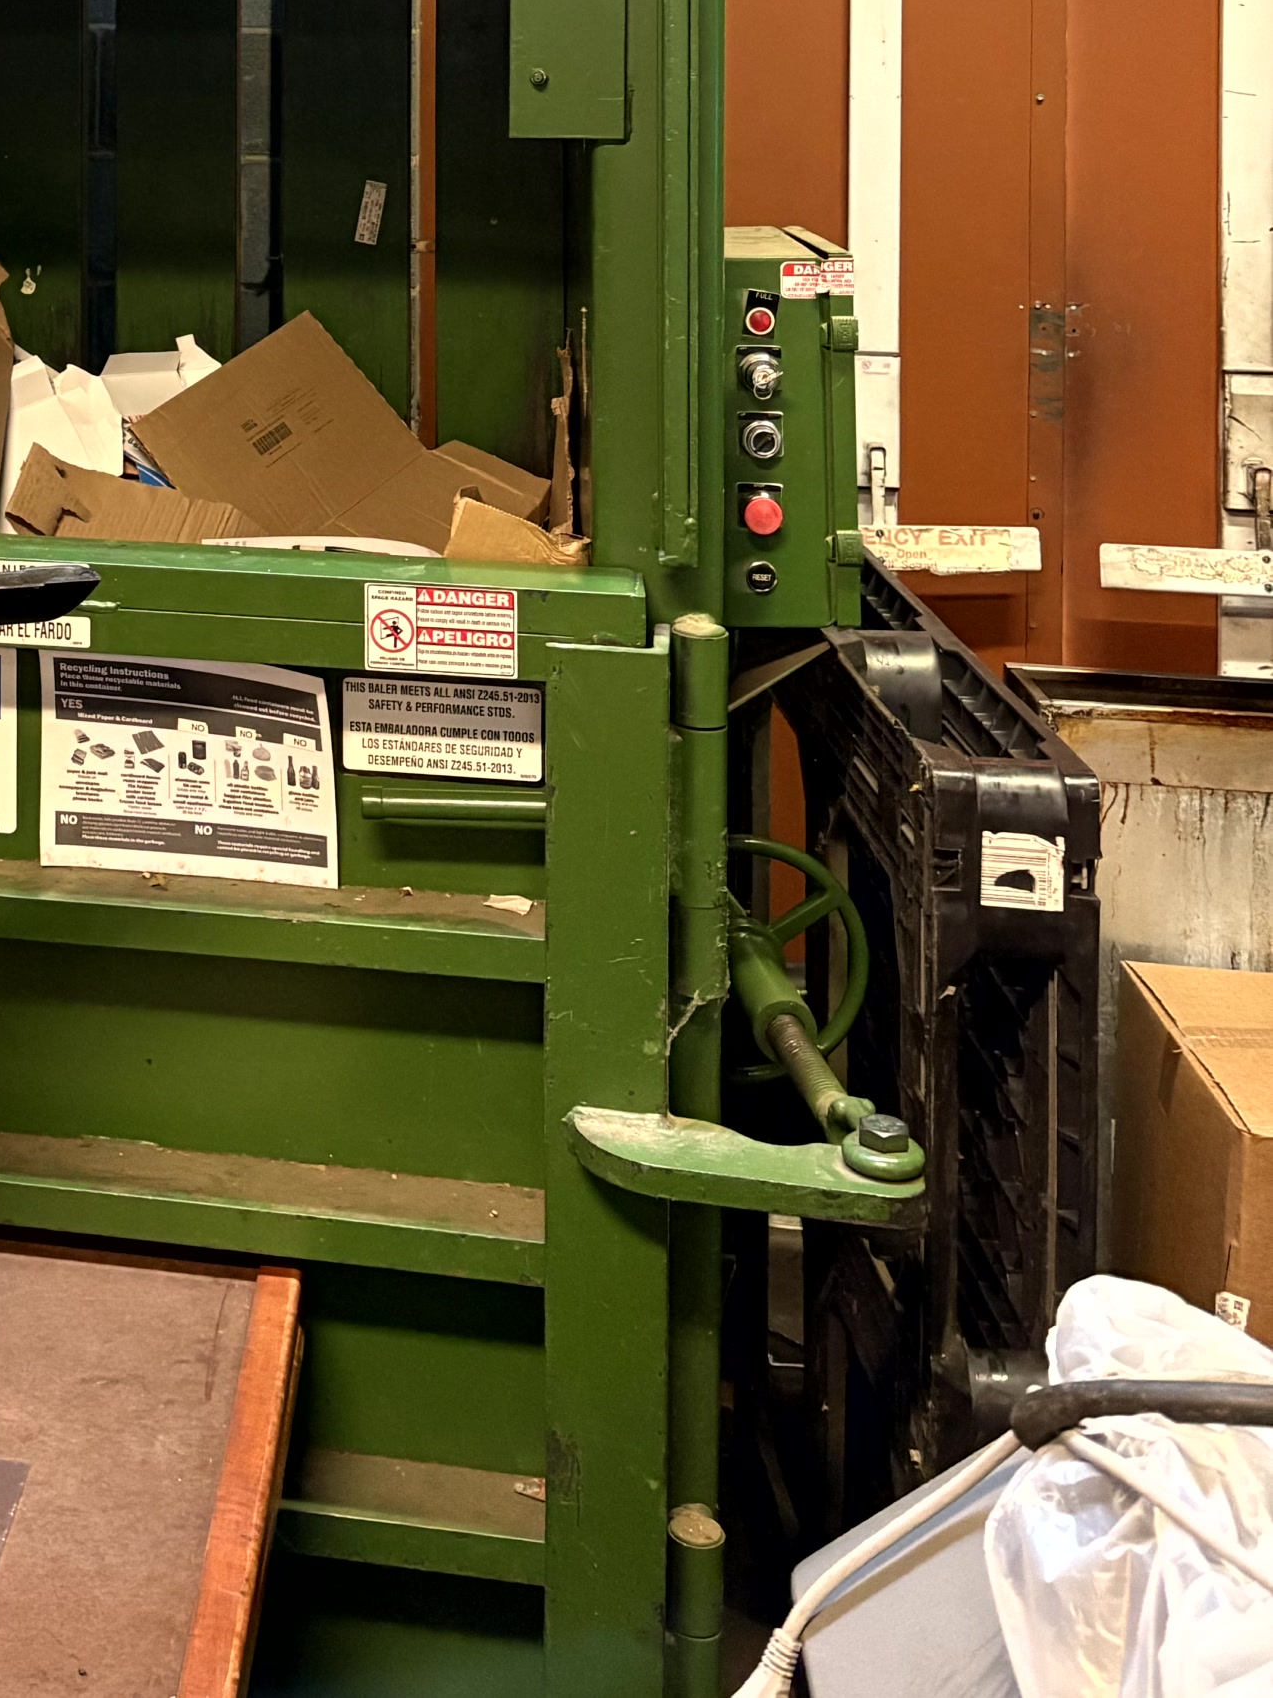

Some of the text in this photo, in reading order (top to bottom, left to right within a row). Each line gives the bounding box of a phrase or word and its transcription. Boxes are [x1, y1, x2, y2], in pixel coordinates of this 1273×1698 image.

[794, 262, 852, 275] DANGER
[756, 292, 773, 300] FULL
[752, 573, 771, 582] RESET
[433, 590, 509, 606] DANGER
[17, 621, 71, 640] EL FARDO
[433, 632, 512, 647] PELIGRO
[60, 662, 169, 680] Recycling Instructions
[345, 682, 540, 703] THIS BALER MEETS ALL ANSI Z245.51-2013
[61, 698, 83, 708] YES
[369, 699, 515, 718] SAFETY & PERFORMANCE STDS.
[191, 724, 205, 732] NO
[240, 730, 252, 738] NO
[350, 721, 534, 742] ESTA EMBALADORA CUMPLE CON TODOS
[293, 739, 307, 747] NO
[362, 738, 522, 757] LOS ESTÁNDARES DE SEGURIDAD Y
[368, 752, 516, 774] DESEMPEÑO ANSI Z245.51-2013.
[60, 814, 78, 825] NO
[195, 825, 213, 835] NO
